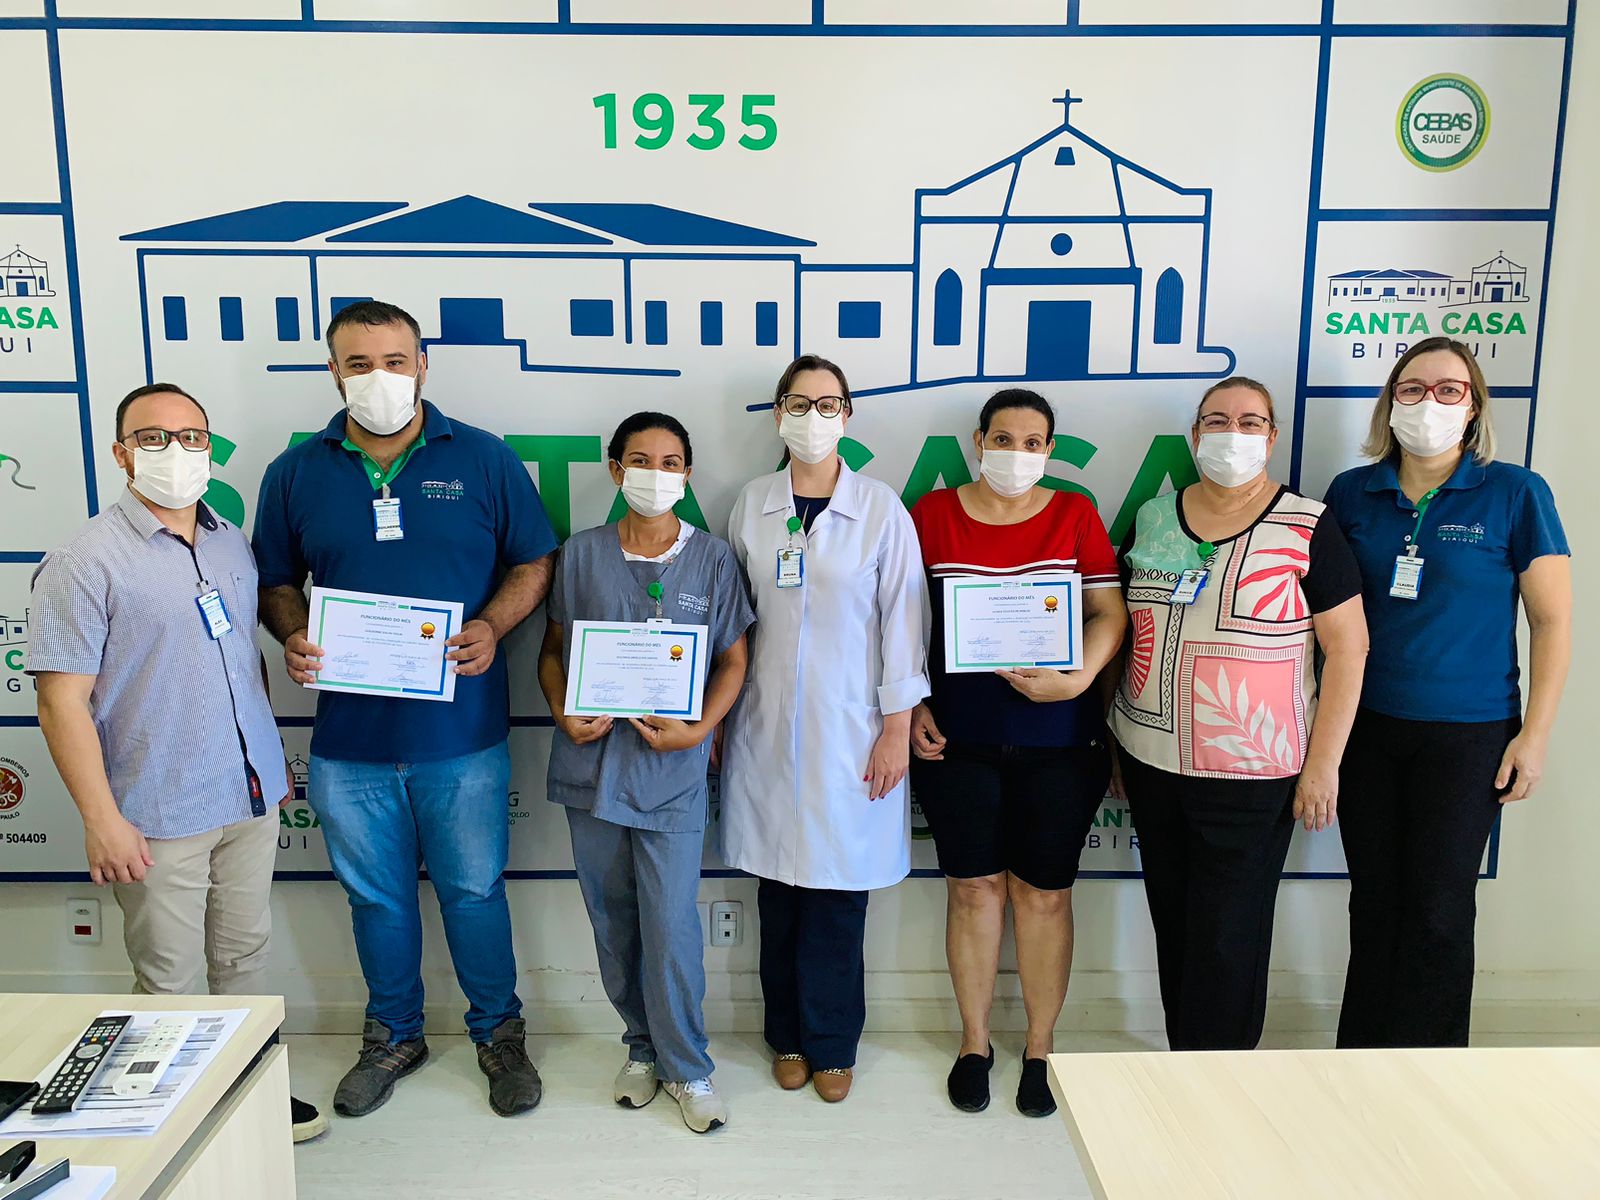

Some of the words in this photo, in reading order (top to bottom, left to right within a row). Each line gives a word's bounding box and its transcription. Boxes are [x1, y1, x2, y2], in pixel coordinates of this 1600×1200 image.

[592, 92, 778, 151] 1935
[1413, 113, 1472, 131] CEBAS
[1422, 132, 1461, 144] SAÚDE
[0, 307, 59, 329] ASA
[1325, 312, 1430, 335] SANTA
[1441, 312, 1527, 335] CASA
[678, 600, 694, 608] SANTA
[694, 604, 708, 612] CASA
[360, 614, 392, 622] FUNCIONÁRIO
[0, 757, 30, 778] OMBEIROS
[0, 811, 20, 820] PAULO
[6, 833, 47, 844] 504409
